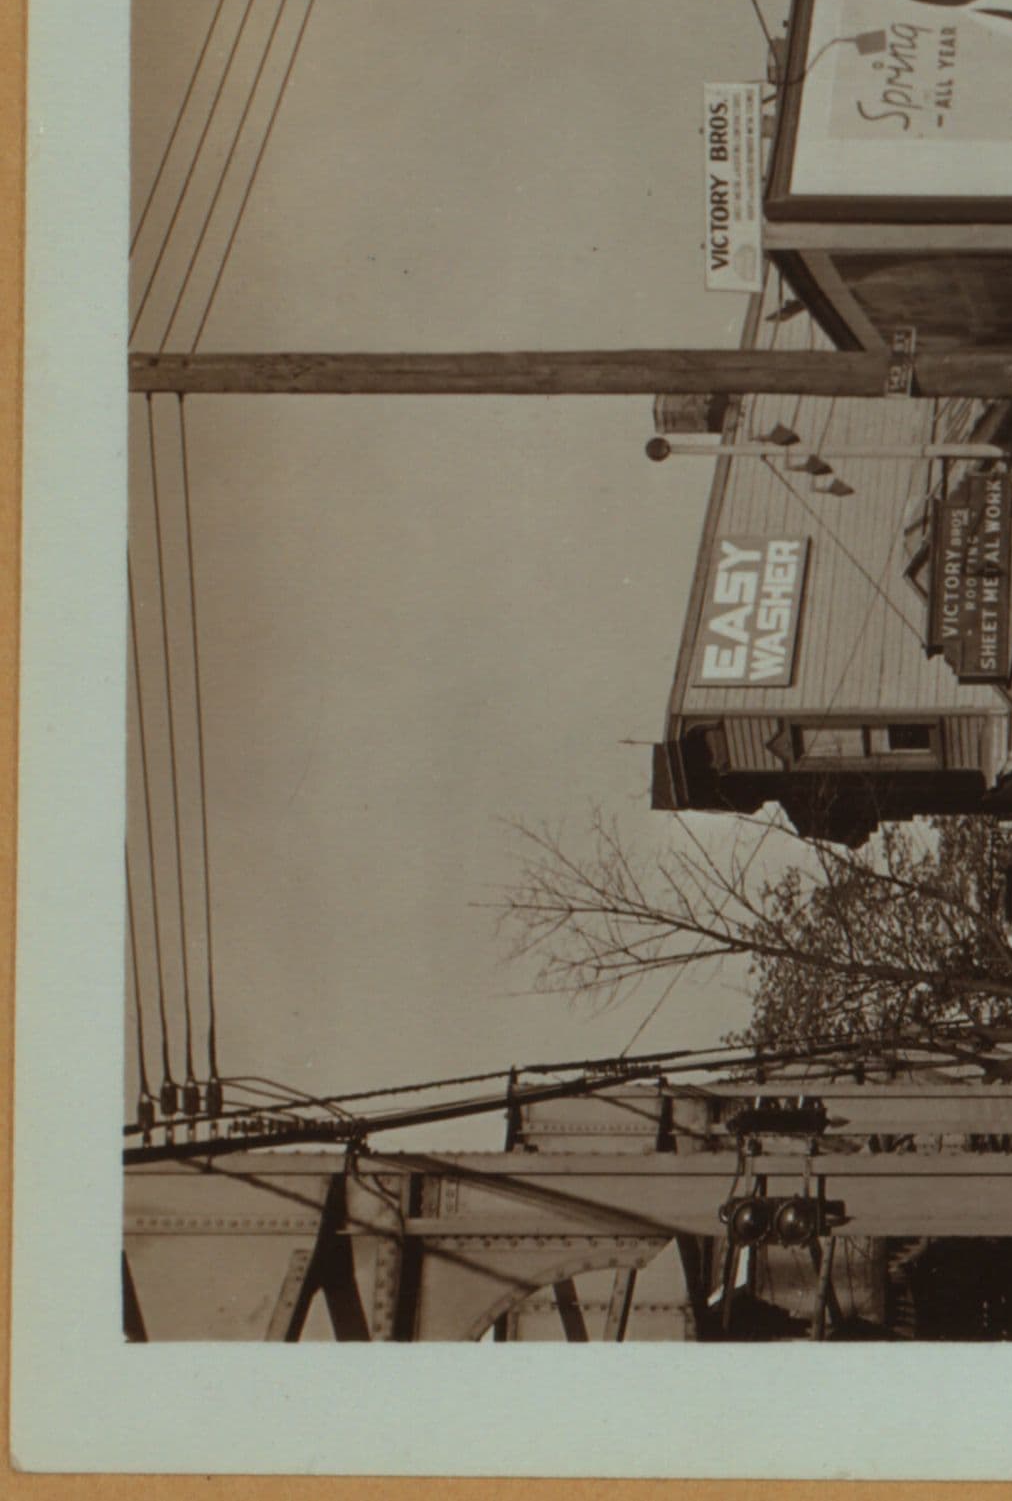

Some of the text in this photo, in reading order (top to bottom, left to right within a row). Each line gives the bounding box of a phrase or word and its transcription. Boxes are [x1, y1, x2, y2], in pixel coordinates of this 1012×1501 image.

[856, 23, 933, 131] Spring
[938, 27, 956, 69] YEAR
[709, 99, 729, 270] VICTORY BROS.
[701, 540, 763, 679] EASY
[749, 540, 800, 681] WASHER
[942, 549, 962, 639] VICTORY
[965, 535, 978, 610] ROOFING
[981, 479, 1002, 669] SHEET METAL WORK
